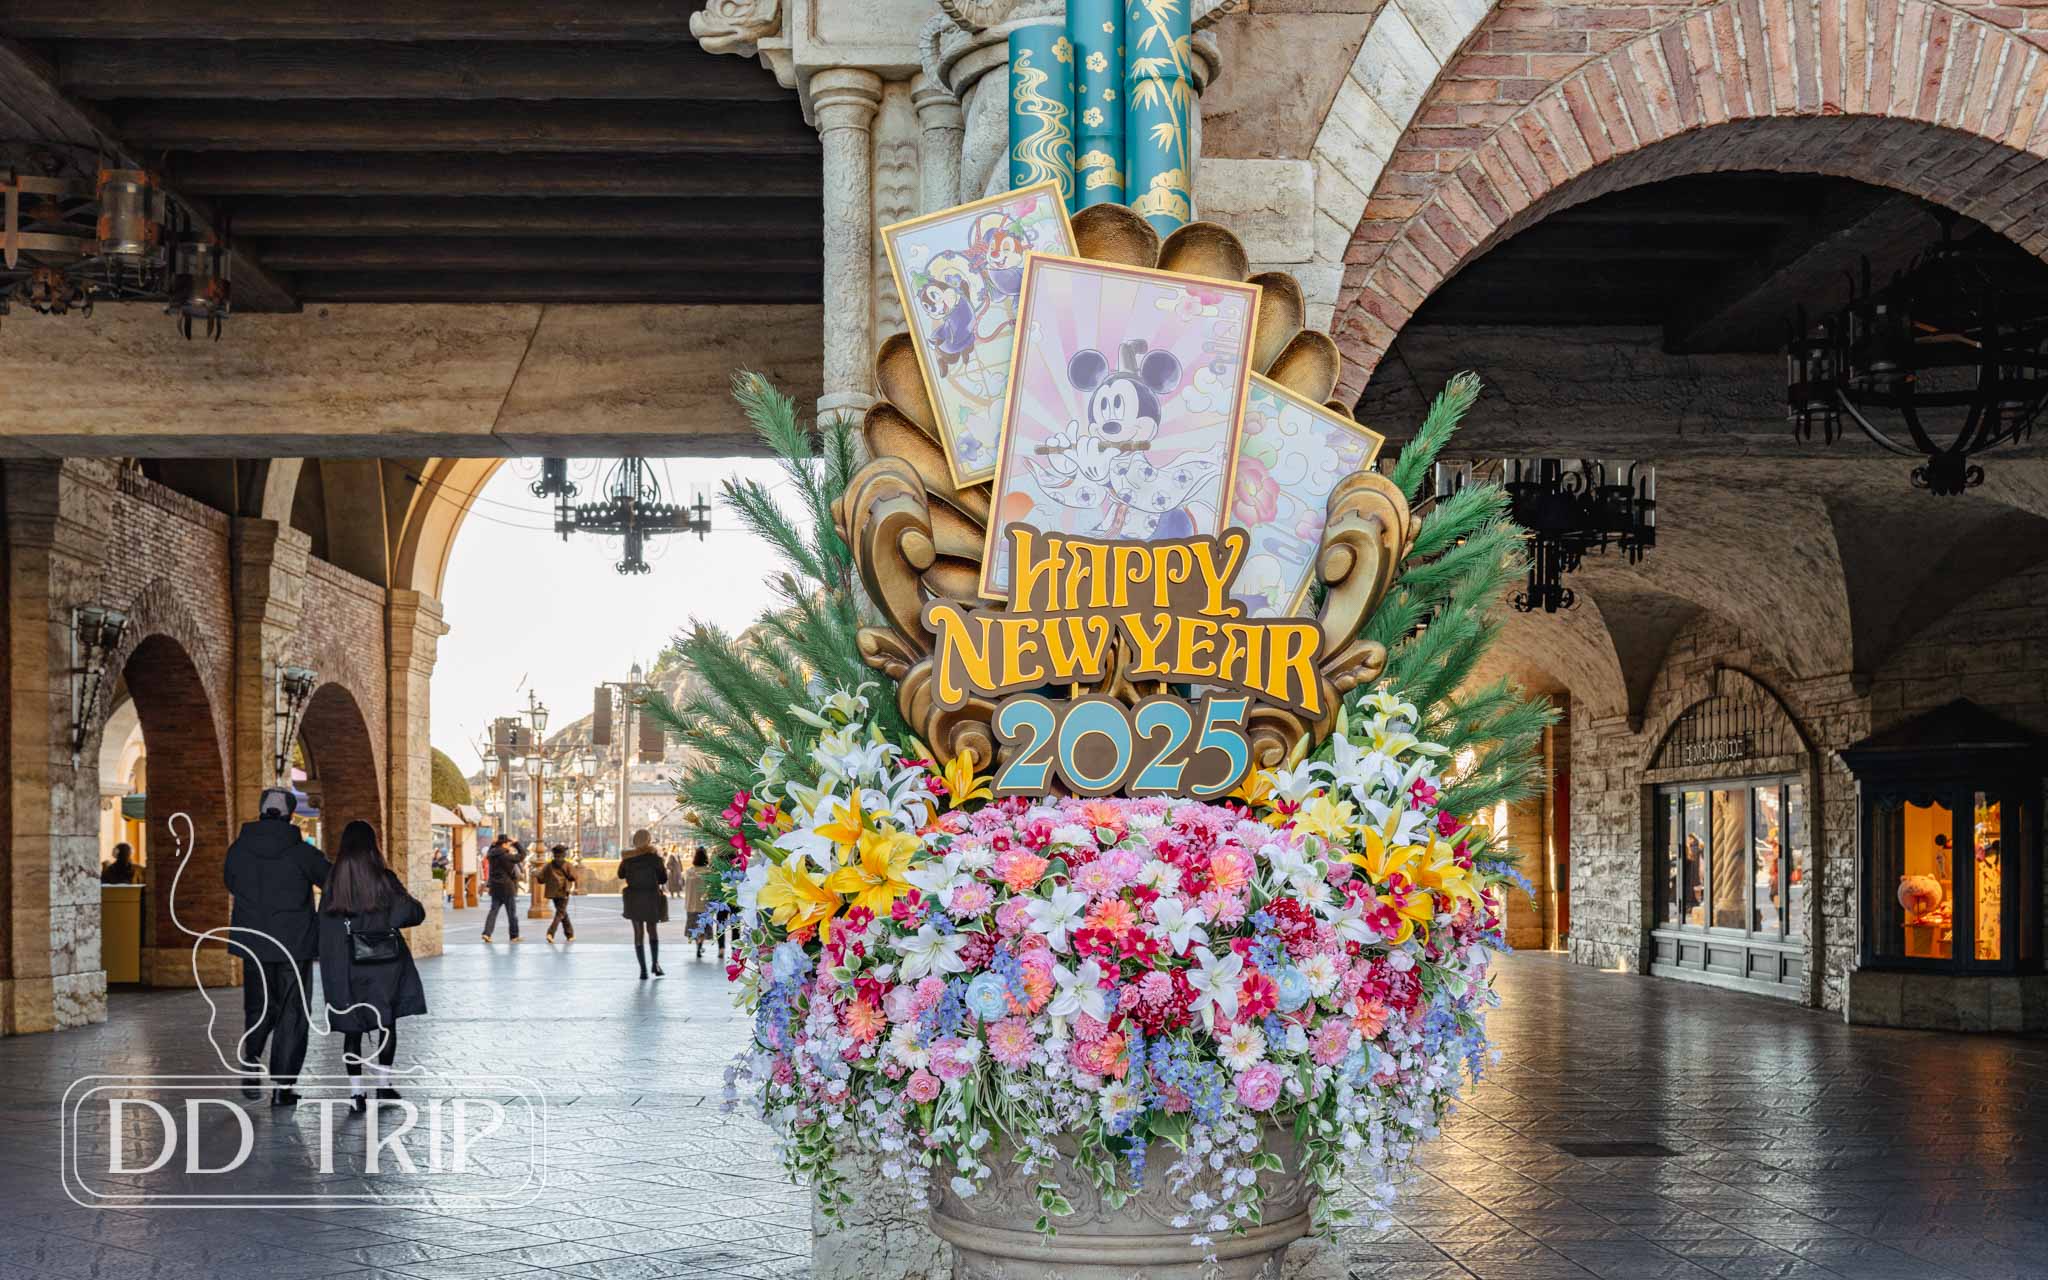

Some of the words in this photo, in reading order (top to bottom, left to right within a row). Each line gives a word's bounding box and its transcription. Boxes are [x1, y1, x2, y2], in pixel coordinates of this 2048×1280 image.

[1009, 528, 1244, 618] HAPPY
[928, 605, 1111, 704] NEW
[1119, 612, 1324, 714] YEAR
[997, 696, 1250, 795] 2025
